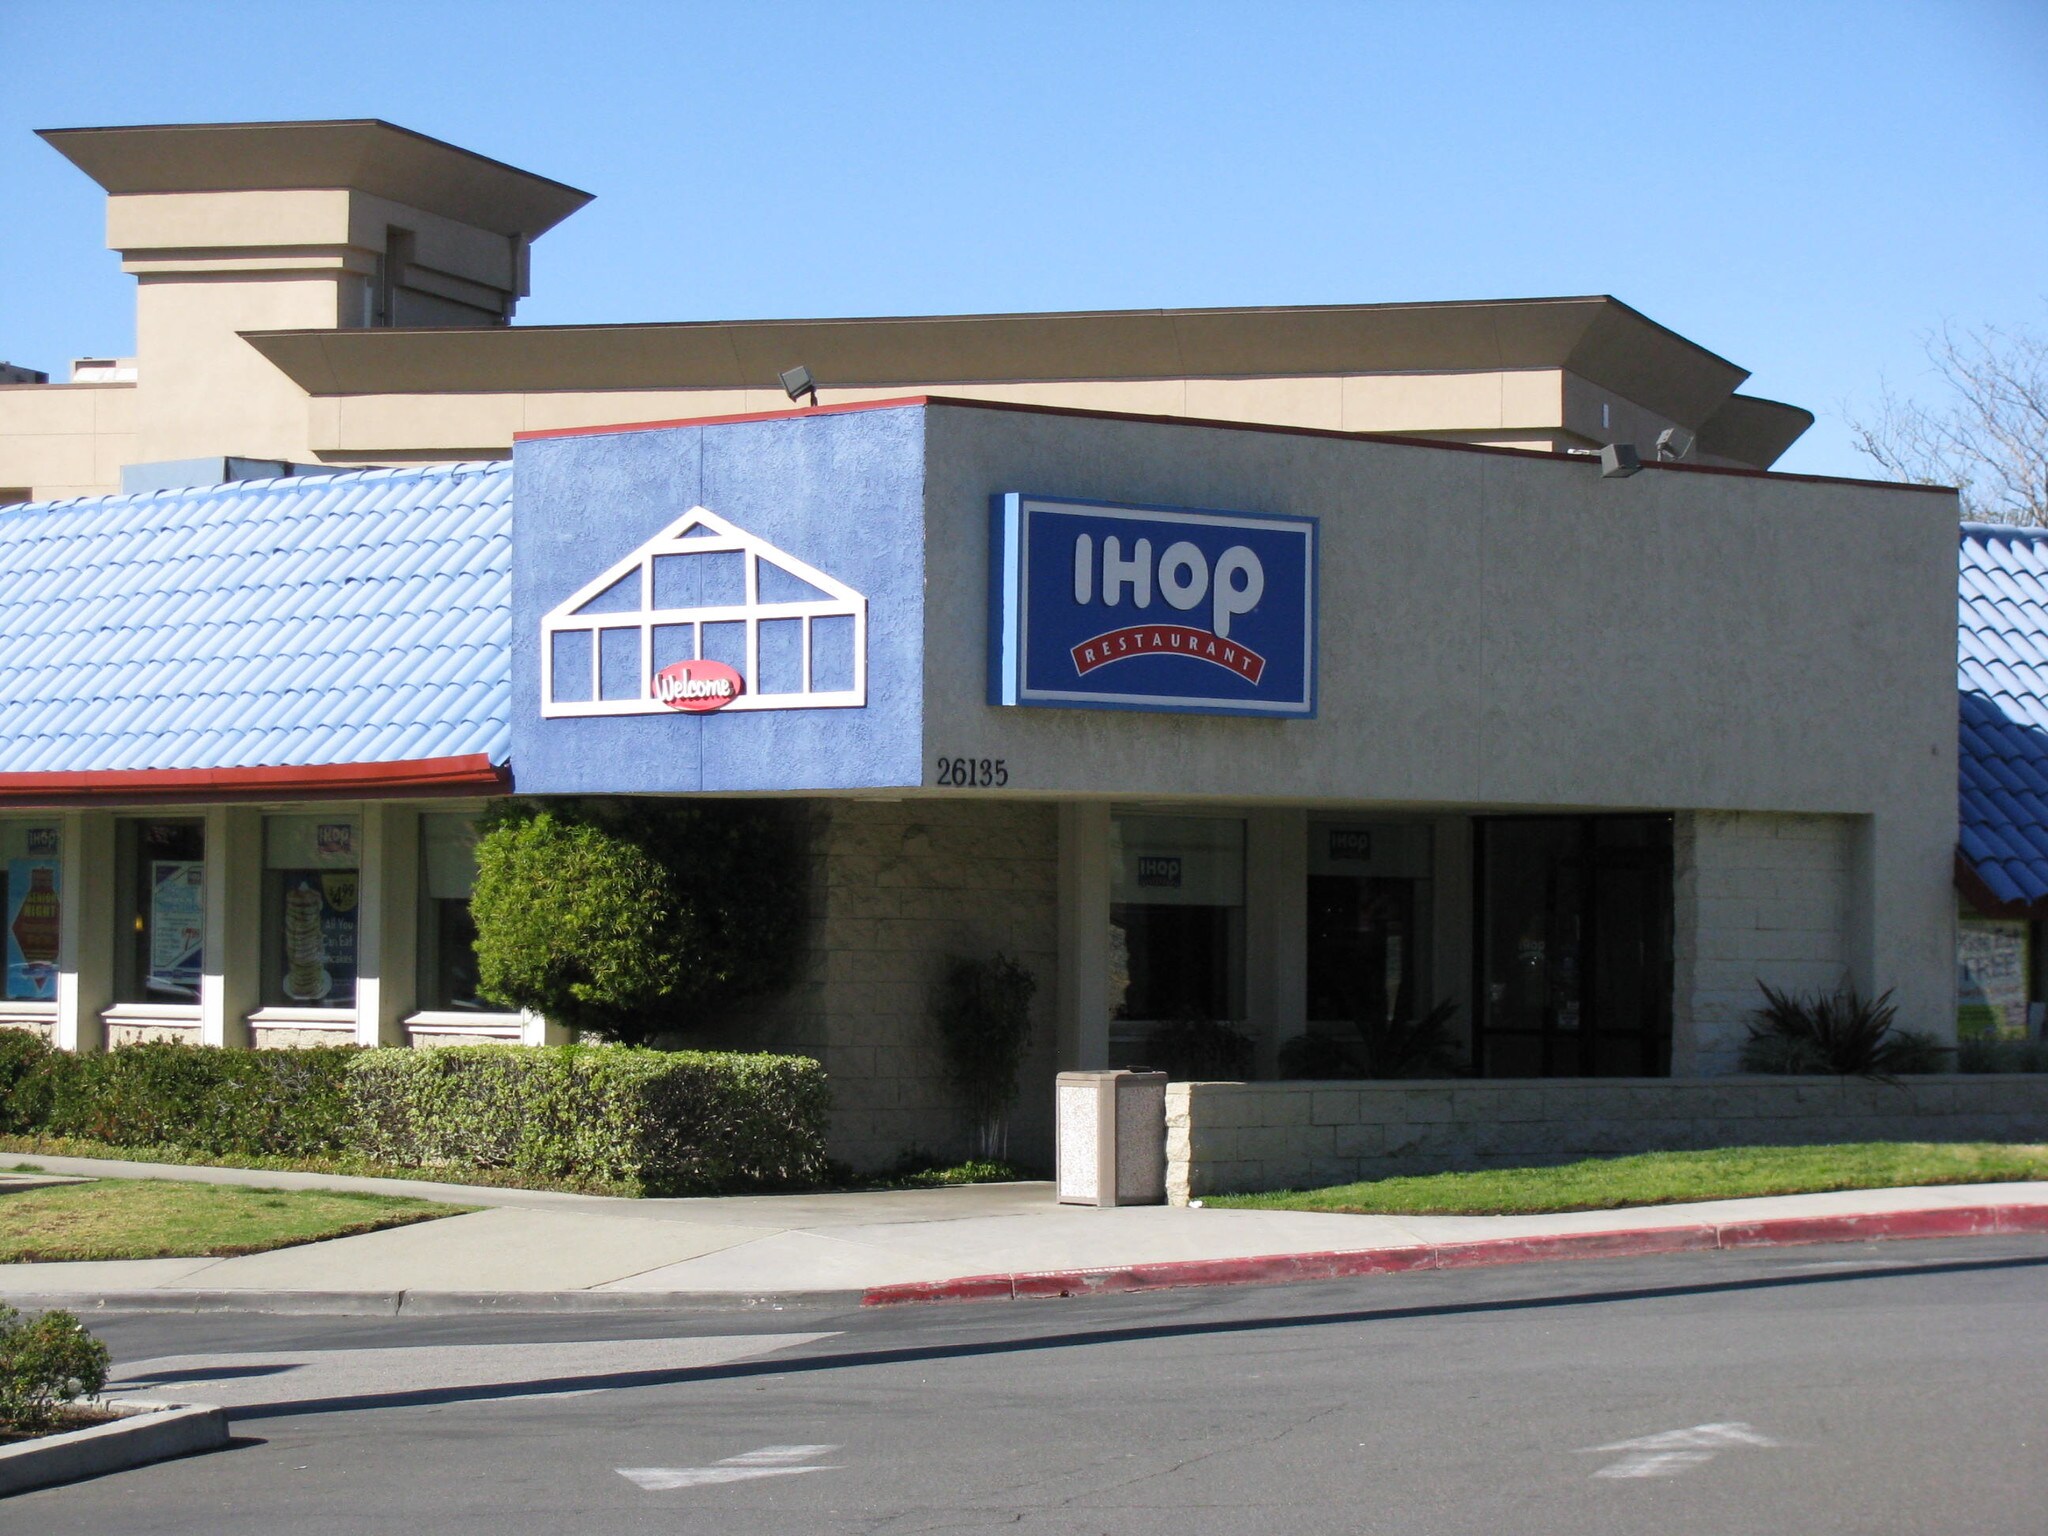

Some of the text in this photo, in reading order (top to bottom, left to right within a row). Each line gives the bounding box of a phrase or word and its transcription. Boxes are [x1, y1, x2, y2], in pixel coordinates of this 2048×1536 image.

[1075, 533, 1264, 638] IHOP
[1085, 633, 1251, 671] RESTAURANT
[654, 668, 730, 702] Welcome
[937, 757, 1008, 786] 26135
[319, 827, 349, 846] IHOP
[1332, 833, 1368, 853] IHOP
[1140, 860, 1179, 881] IHOP
[338, 918, 353, 930] You
[339, 933, 353, 946] Eat
